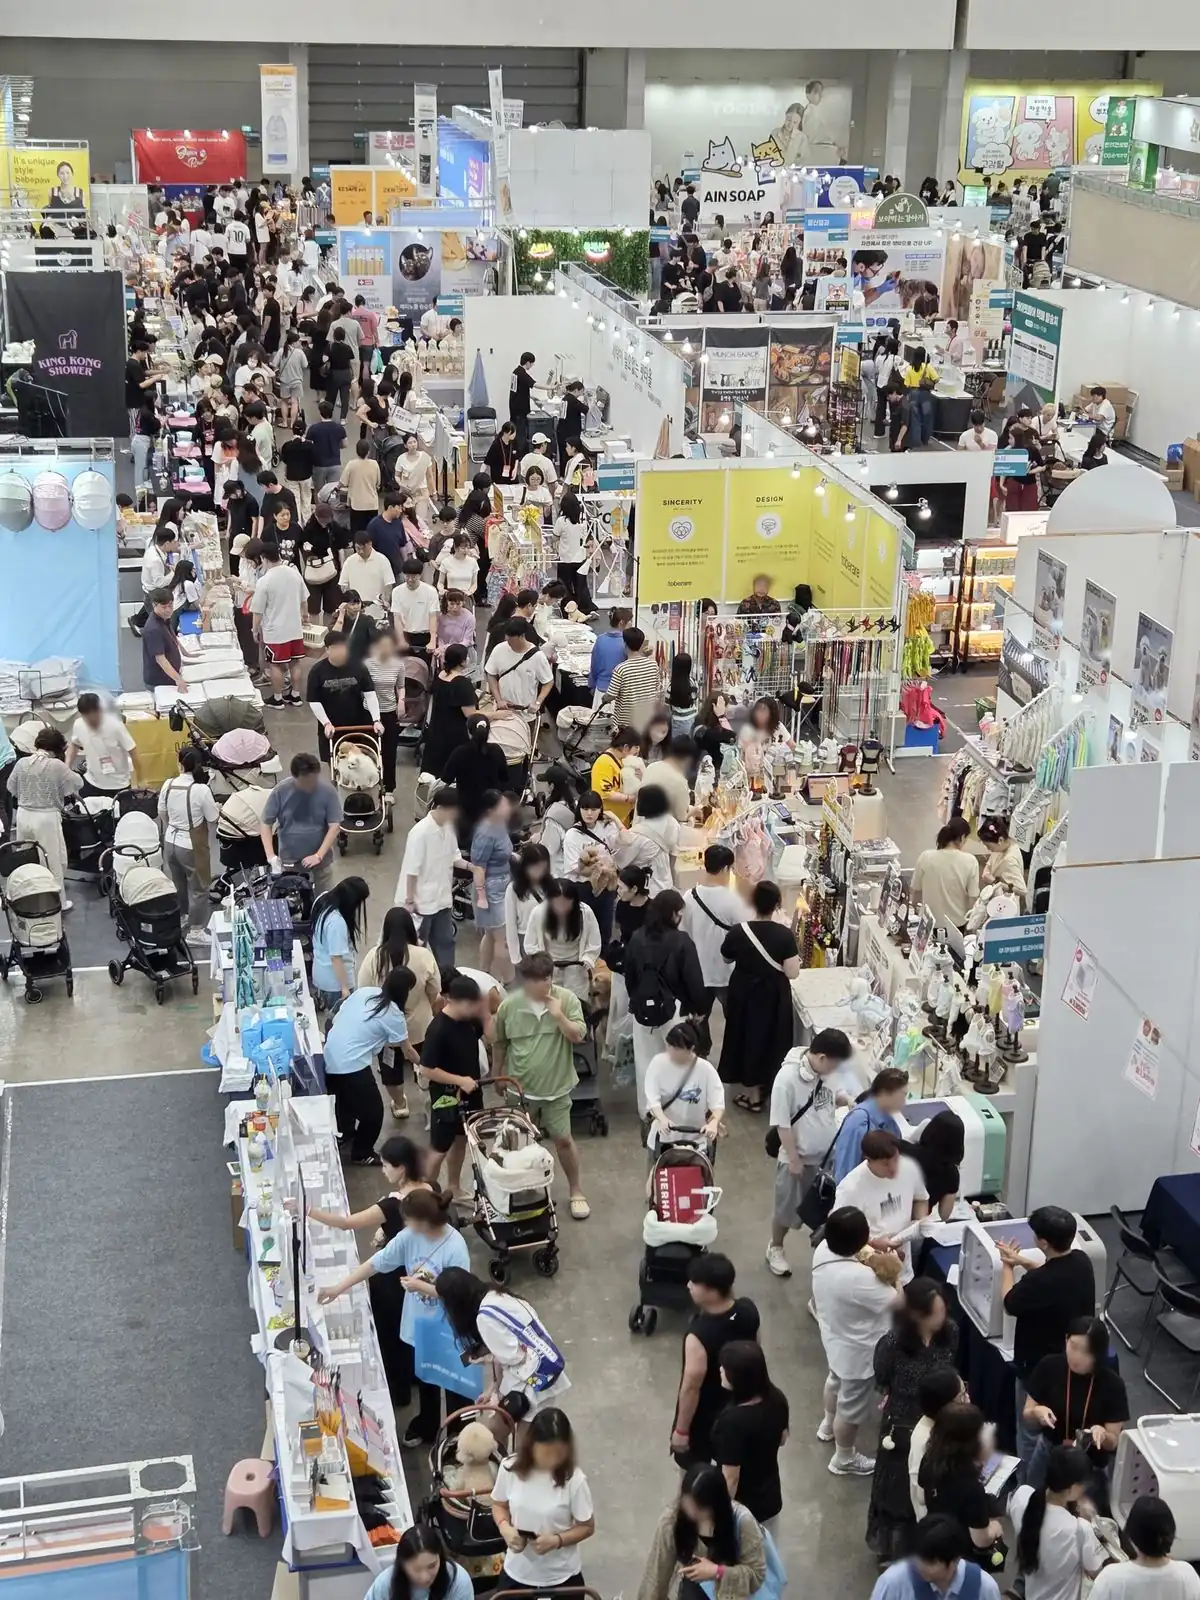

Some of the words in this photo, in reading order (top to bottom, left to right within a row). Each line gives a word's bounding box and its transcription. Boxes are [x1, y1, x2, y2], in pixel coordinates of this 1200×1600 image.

[14, 156, 25, 165] It's
[28, 158, 56, 166] unique
[15, 166, 34, 175] style
[704, 190, 728, 203] AIN
[729, 189, 766, 203] SOAP
[233, 230, 244, 242] 10
[37, 357, 66, 369] KING
[69, 356, 102, 369] KONG
[48, 366, 93, 377] SHOWER
[755, 496, 784, 504] DESIGN
[1024, 926, 1045, 935] B-03
[659, 1168, 671, 1224] TIERHA
